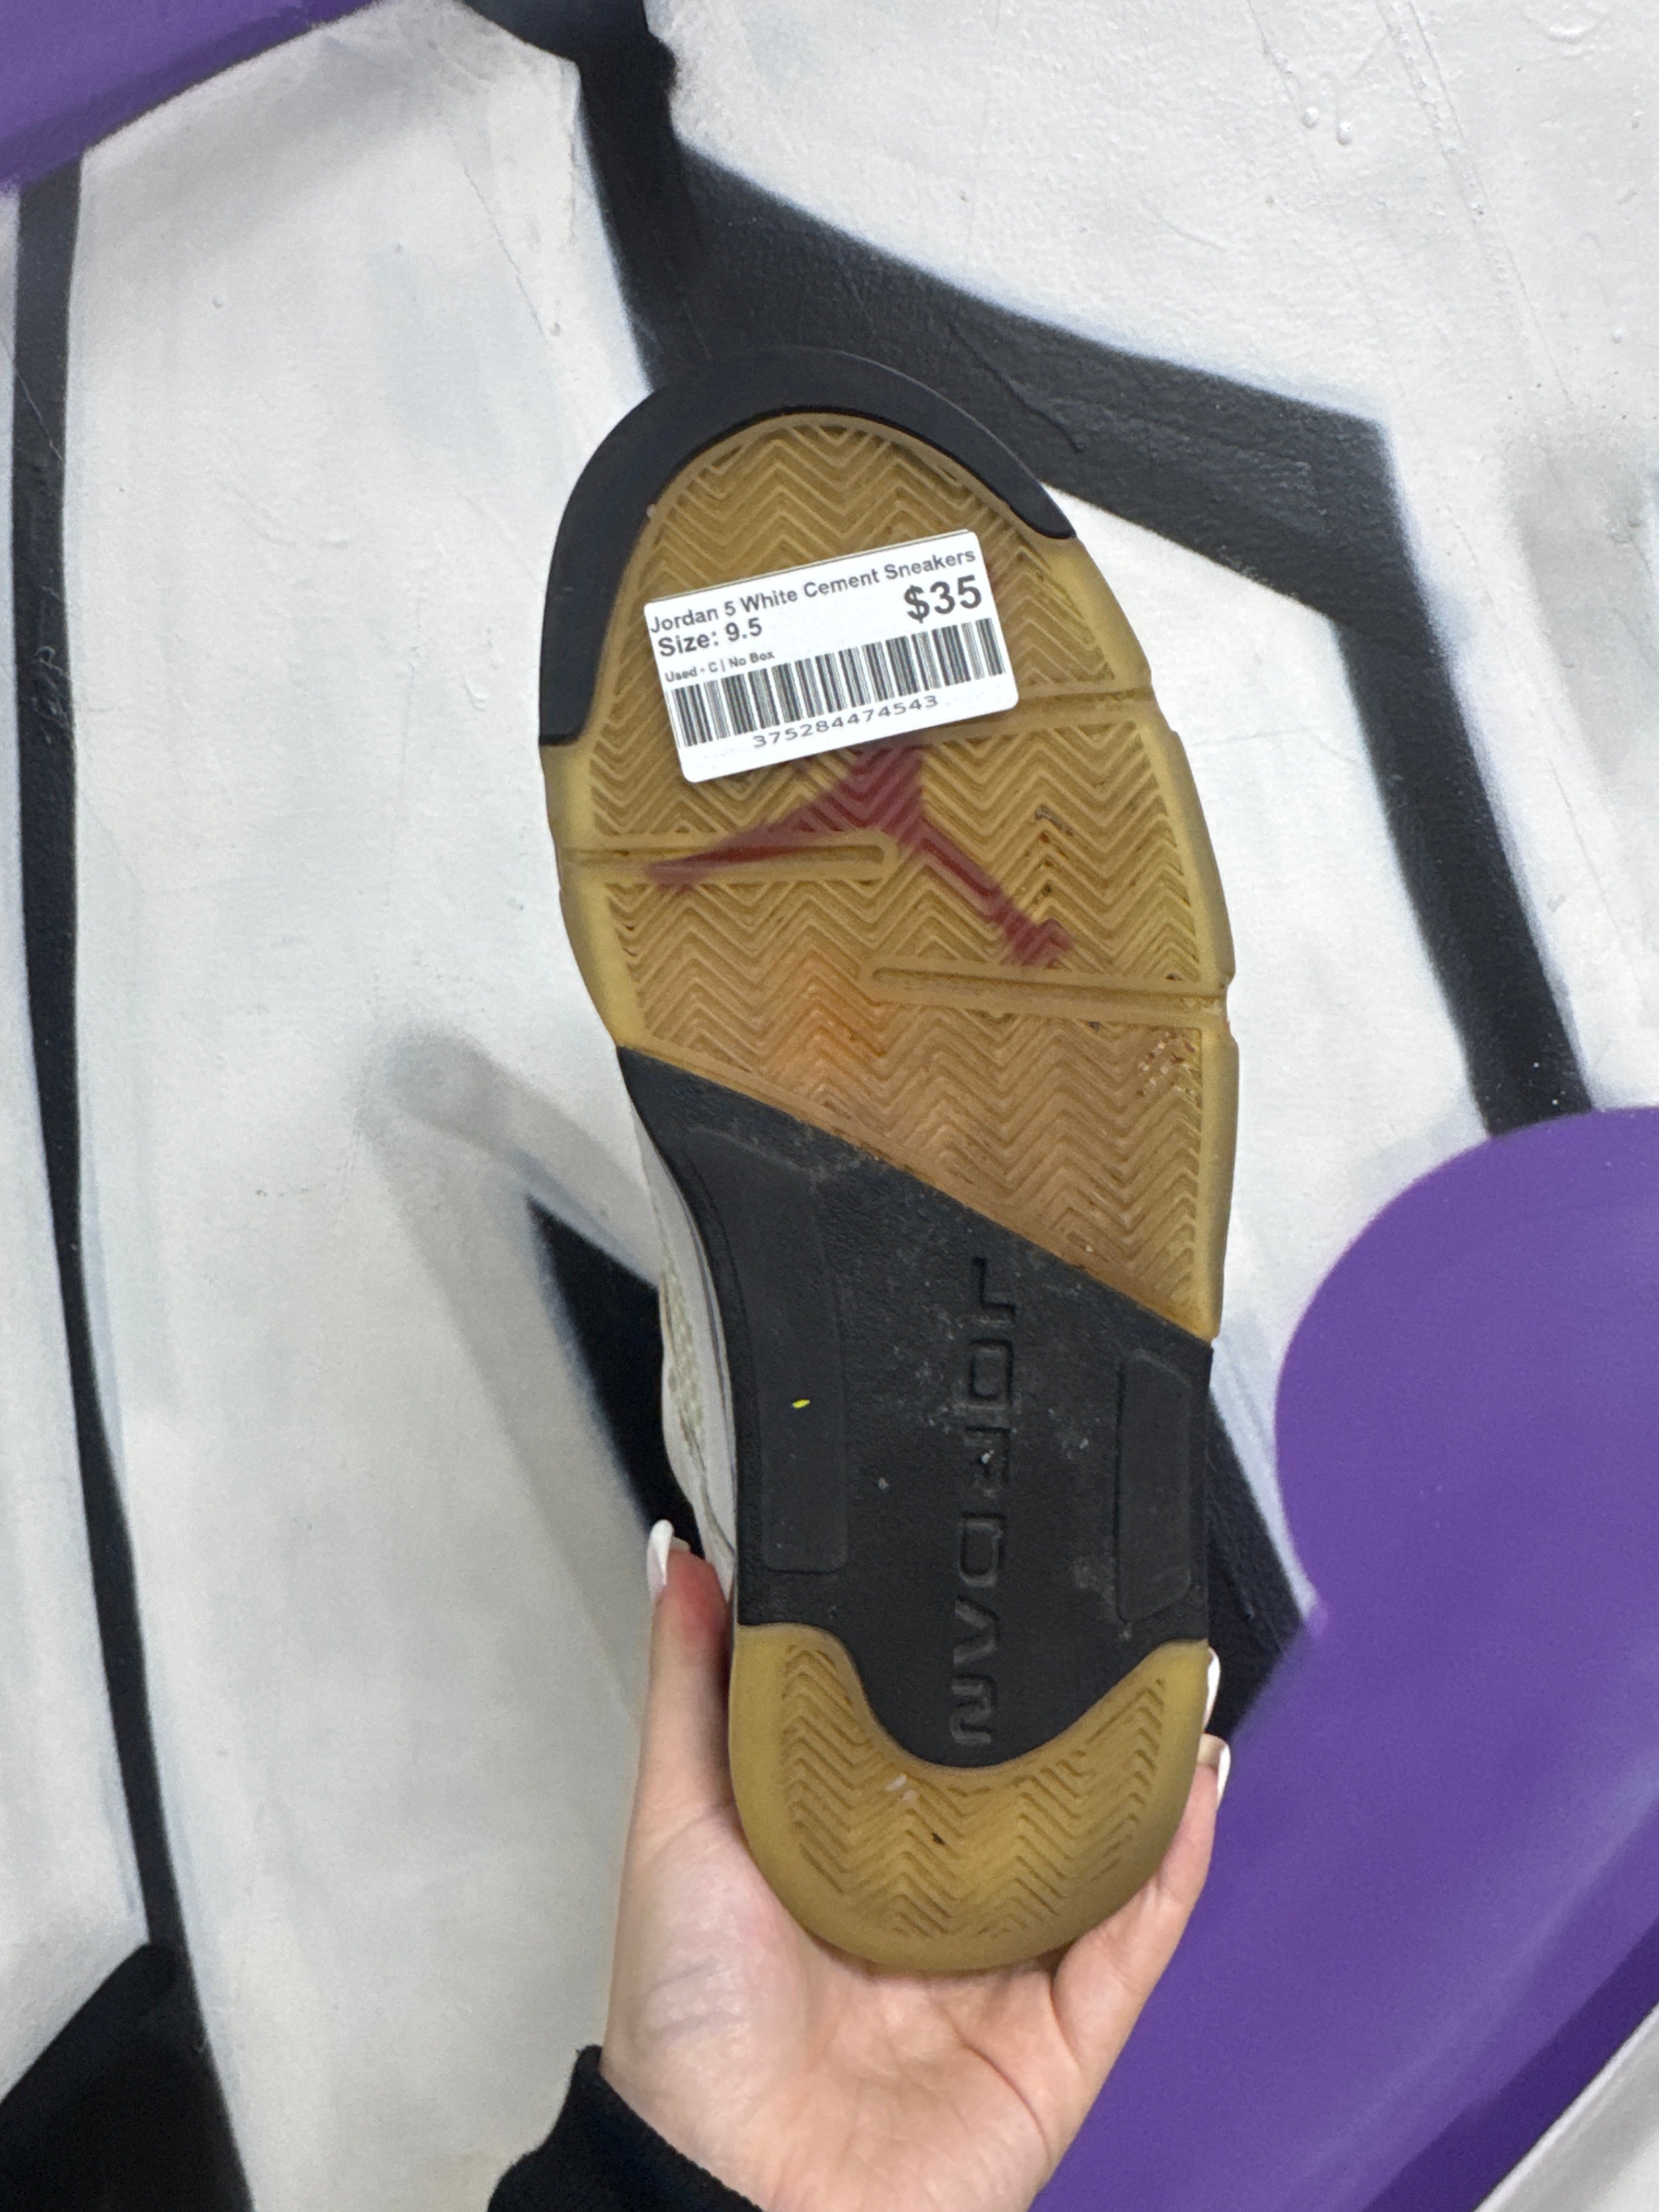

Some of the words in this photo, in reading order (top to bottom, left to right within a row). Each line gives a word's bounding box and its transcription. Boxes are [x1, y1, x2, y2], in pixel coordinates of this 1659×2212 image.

[651, 608, 719, 633] Jordan
[724, 600, 736, 617] 5
[740, 587, 798, 613] White
[804, 568, 879, 597] Cement
[884, 550, 977, 579] Sneakers
[904, 574, 982, 623] $35
[658, 630, 719, 657] Size:
[725, 617, 763, 642] 9.5
[664, 667, 697, 682] Used
[708, 662, 718, 673] C
[728, 657, 747, 668] No
[749, 651, 775, 663] Box
[753, 695, 939, 748] 375284474543
[950, 1255, 1015, 1746] JORDAN
